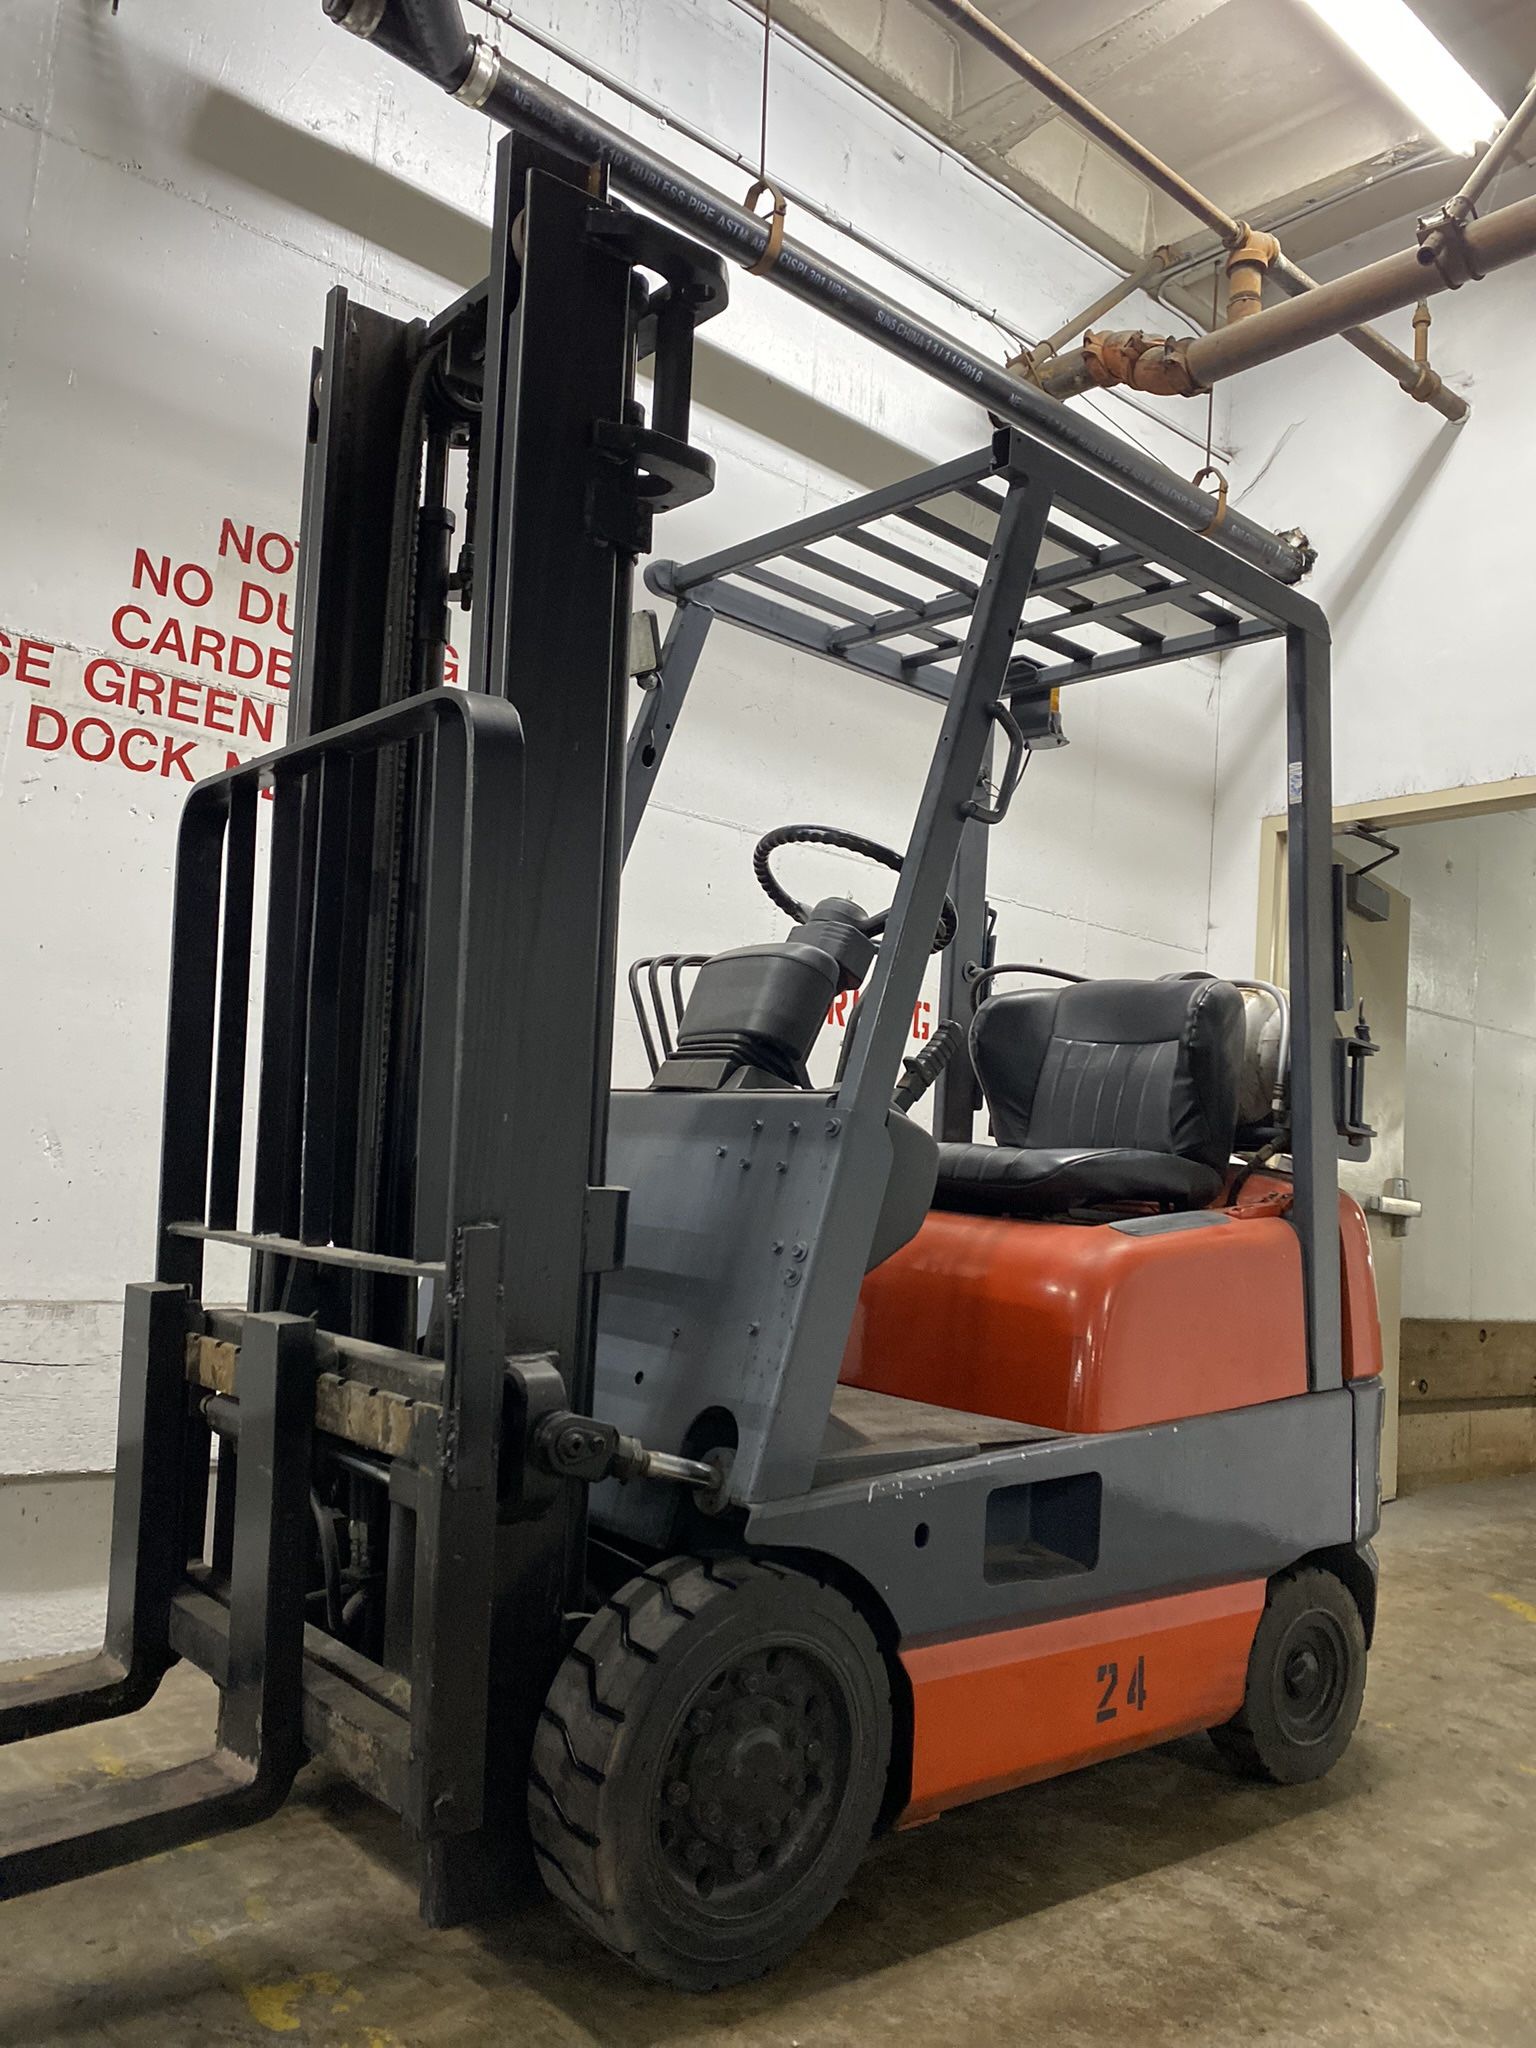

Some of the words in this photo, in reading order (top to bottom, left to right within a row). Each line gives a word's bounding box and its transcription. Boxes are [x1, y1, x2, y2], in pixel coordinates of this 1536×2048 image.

[687, 195, 716, 221] PIPE
[717, 217, 751, 241] ASTM
[809, 270, 828, 288] 301
[875, 311, 898, 332] SUNS
[896, 322, 928, 346] CHINA
[133, 549, 213, 608] NO
[84, 658, 274, 742] GREEN
[26, 705, 196, 782] DOCK
[1096, 1655, 1146, 1724] 24
